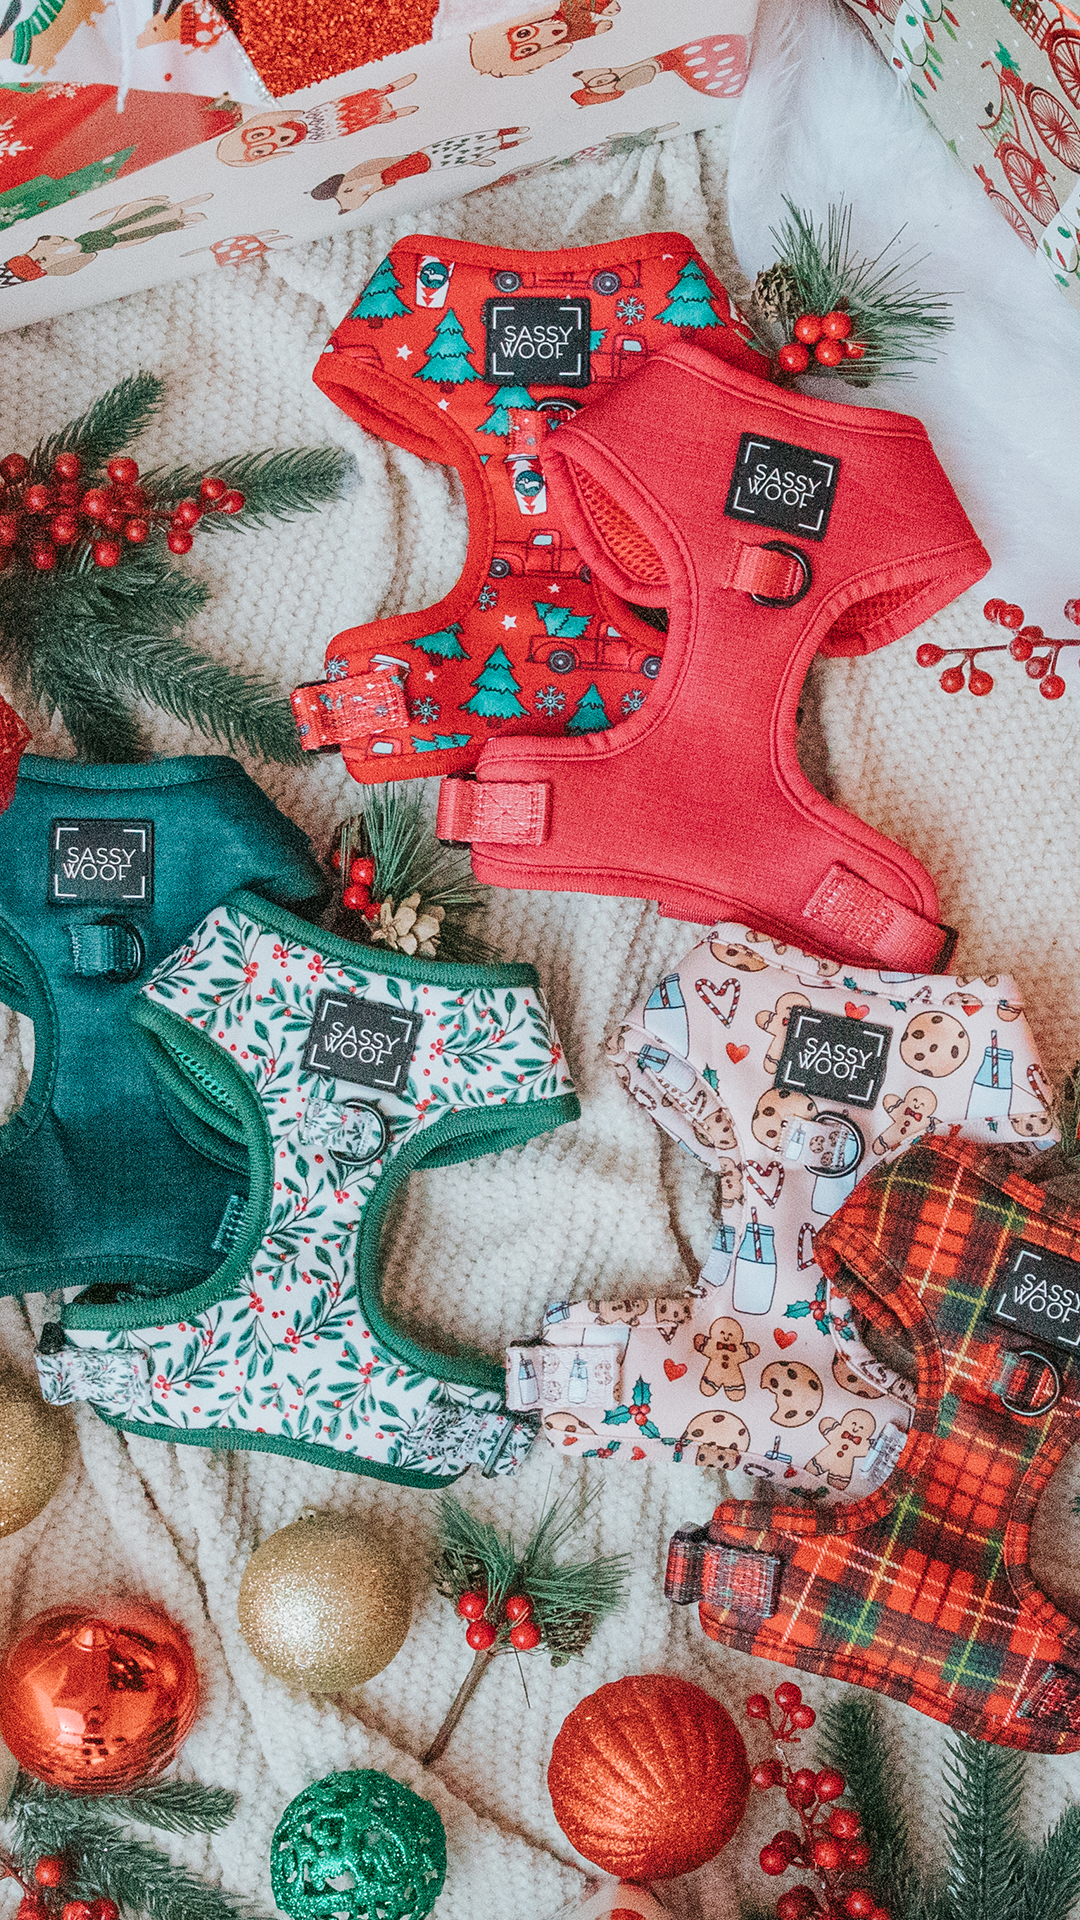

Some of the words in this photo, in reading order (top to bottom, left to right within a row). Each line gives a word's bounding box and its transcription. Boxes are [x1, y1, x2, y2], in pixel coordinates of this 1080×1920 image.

[504, 325, 573, 343] SASSY
[500, 341, 569, 359] WOOF
[748, 477, 813, 509] WOOF
[754, 463, 821, 494] SASSY
[67, 846, 136, 865] SASSY
[63, 862, 130, 881] WOOF
[324, 1034, 392, 1064] WOOF
[331, 1022, 400, 1053] SASSY
[804, 1037, 872, 1066] SASSY
[798, 1050, 868, 1082] WOOF
[1014, 1285, 1079, 1323] WOOF
